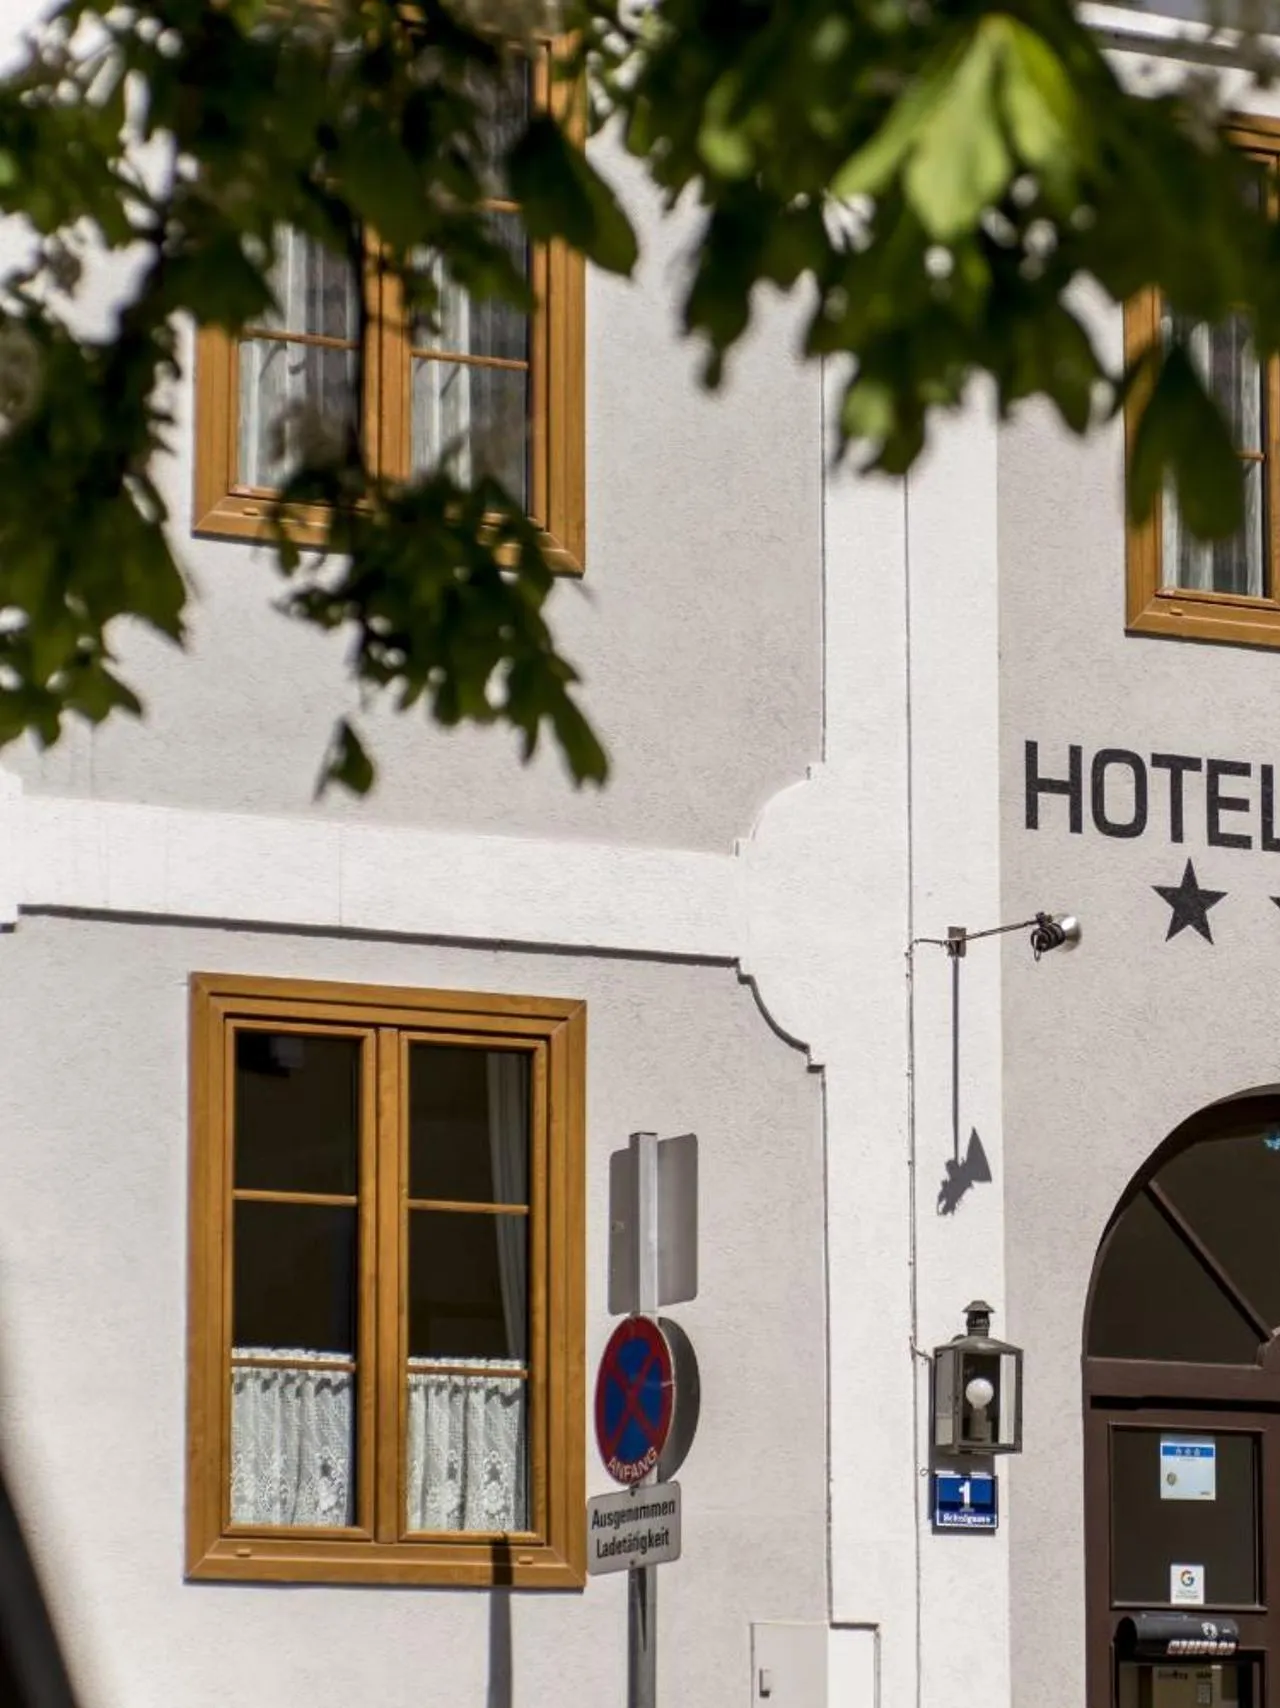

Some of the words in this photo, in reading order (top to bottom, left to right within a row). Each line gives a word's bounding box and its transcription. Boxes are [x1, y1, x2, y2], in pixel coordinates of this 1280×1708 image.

[608, 1446, 659, 1479] ANFANG
[957, 1480, 976, 1513] 1
[591, 1500, 676, 1530] Ausgenommen
[596, 1526, 670, 1559] Ladetätigkeit
[1180, 1569, 1196, 1587] G
